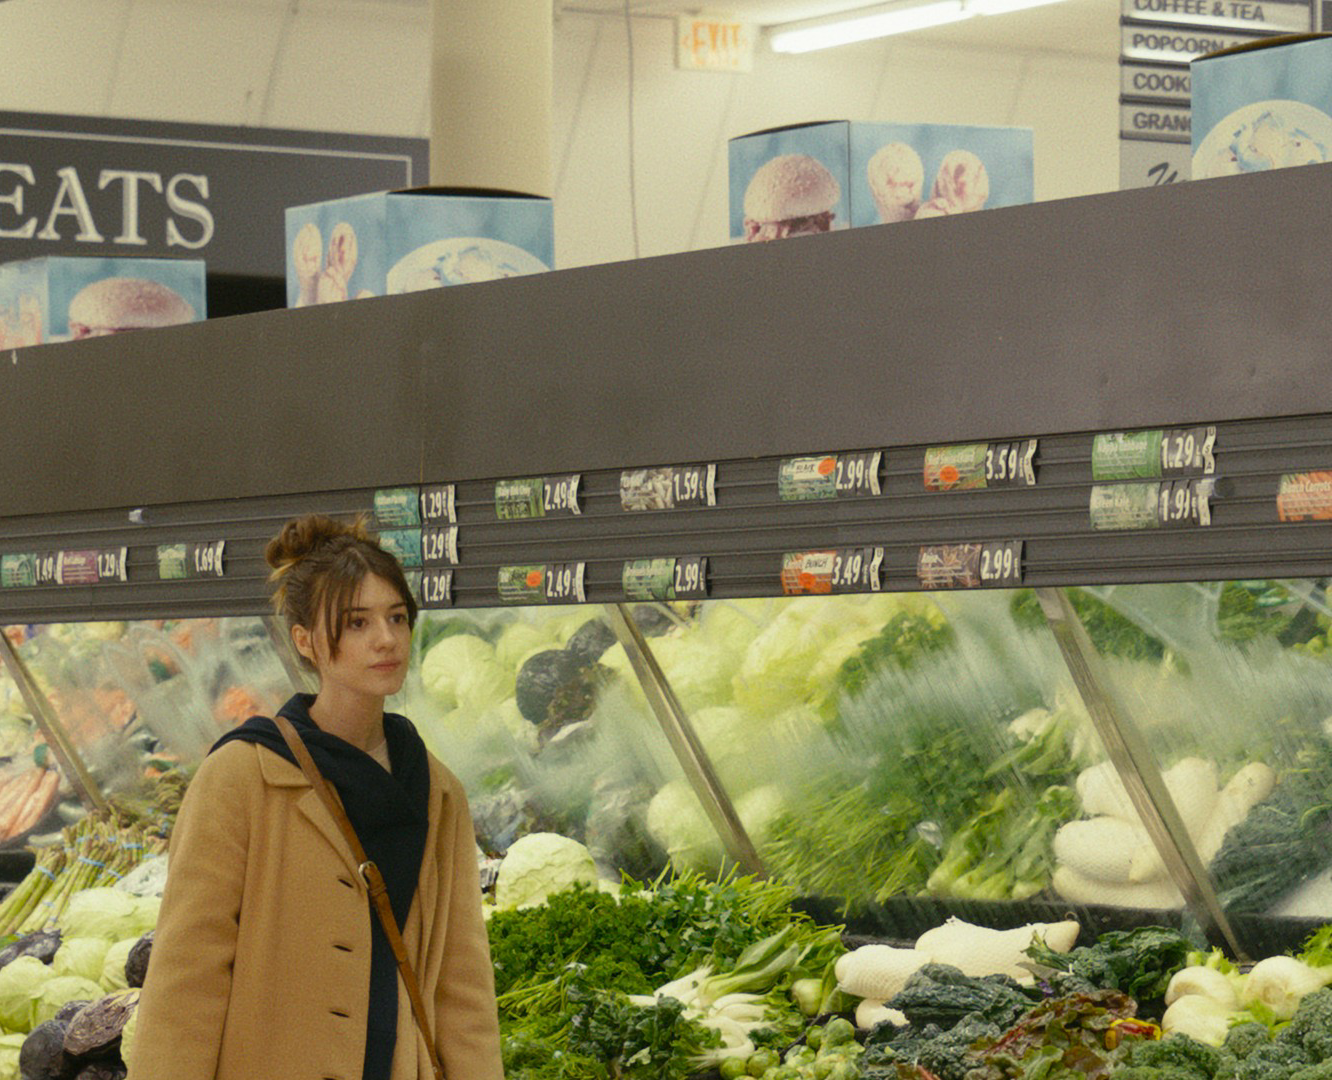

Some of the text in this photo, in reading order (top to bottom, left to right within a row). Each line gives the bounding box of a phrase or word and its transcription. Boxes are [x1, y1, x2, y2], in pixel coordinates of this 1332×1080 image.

[1134, 0, 1265, 21] COFFEE & TEA
[1132, 33, 1225, 54] POPCORN
[1132, 72, 1191, 92] COOK
[986, 448, 1017, 480] 3.59
[1161, 434, 1194, 468] 1.29
[673, 471, 700, 502] 1.59
[836, 459, 865, 490] 2.99
[420, 491, 442, 519] 1.29
[544, 482, 567, 510] 2.49
[422, 533, 444, 561] 1.29
[675, 563, 700, 593] 2.99
[832, 554, 862, 586] 3.49
[981, 548, 1013, 581] 2.99
[423, 574, 446, 602] 1.29
[546, 569, 572, 597] 2.49
